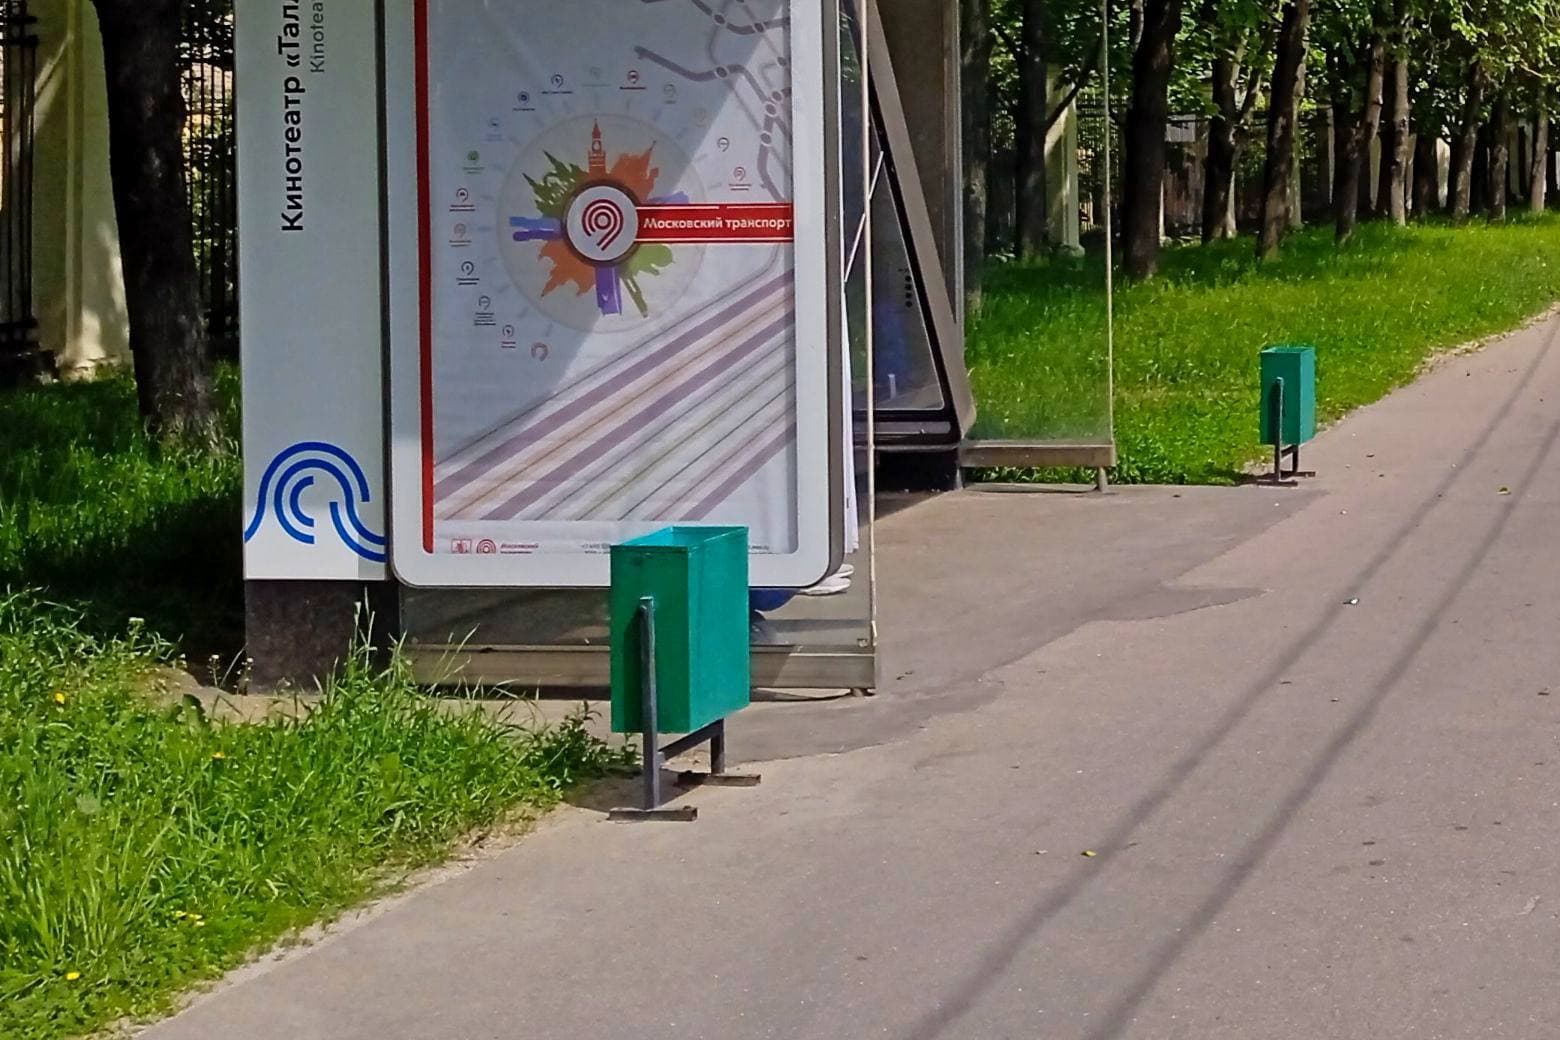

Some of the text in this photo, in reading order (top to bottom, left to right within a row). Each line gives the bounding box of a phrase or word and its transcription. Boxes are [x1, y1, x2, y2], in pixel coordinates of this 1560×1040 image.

[281, 76, 305, 231] Кинотеатр
[643, 216, 792, 231] Московский транспорт
